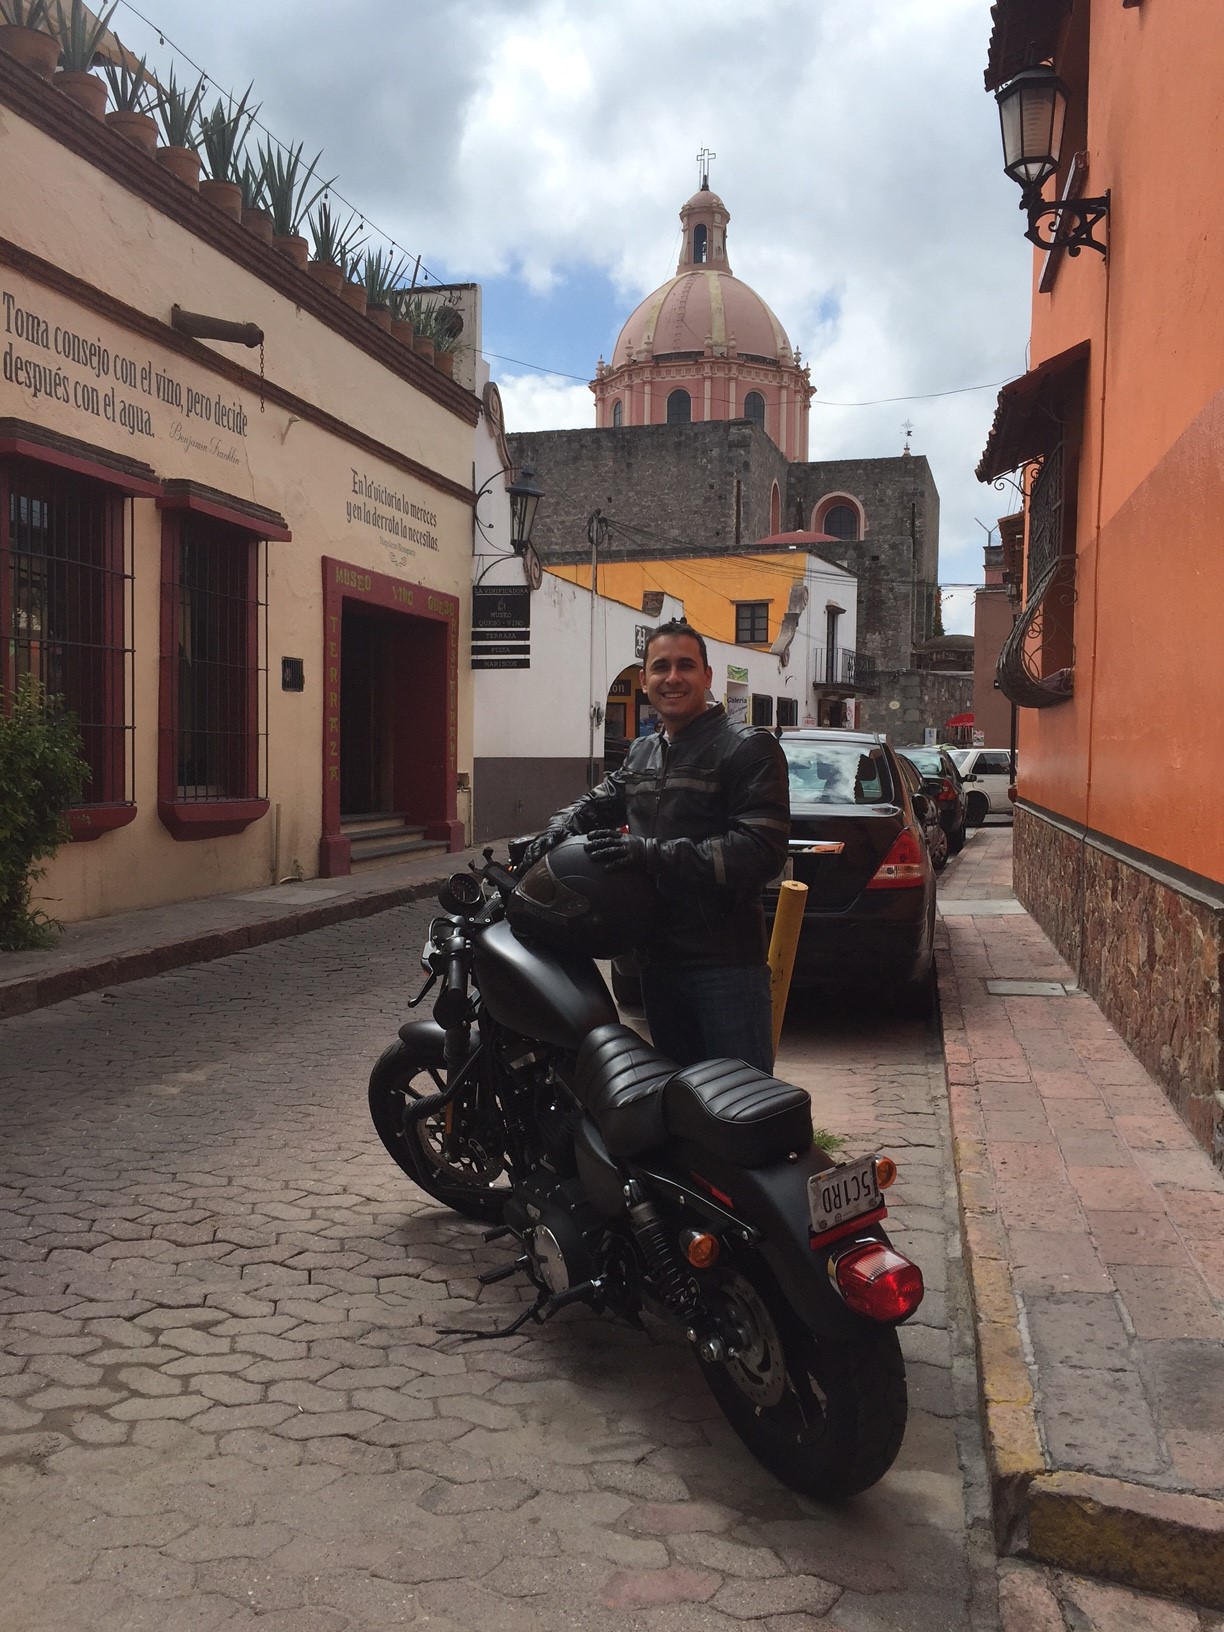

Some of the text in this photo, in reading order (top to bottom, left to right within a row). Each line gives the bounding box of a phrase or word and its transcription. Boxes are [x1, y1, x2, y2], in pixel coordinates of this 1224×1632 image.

[2, 291, 248, 437] Toma consejo con el vino, pero decide
[3, 342, 155, 438] después con el agua.
[168, 421, 240, 465] Benjamin Franklin
[346, 501, 352, 524] y
[353, 503, 362, 521] en
[363, 501, 371, 525] la
[372, 506, 400, 536] derrota
[400, 518, 408, 539] la
[351, 467, 364, 496] En
[373, 483, 402, 513] victoria
[402, 494, 410, 515] lo
[410, 503, 438, 528] mereces
[335, 566, 455, 616] MUSEO VINO QUESO
[822, 1171, 871, 1213] 5C1RD
